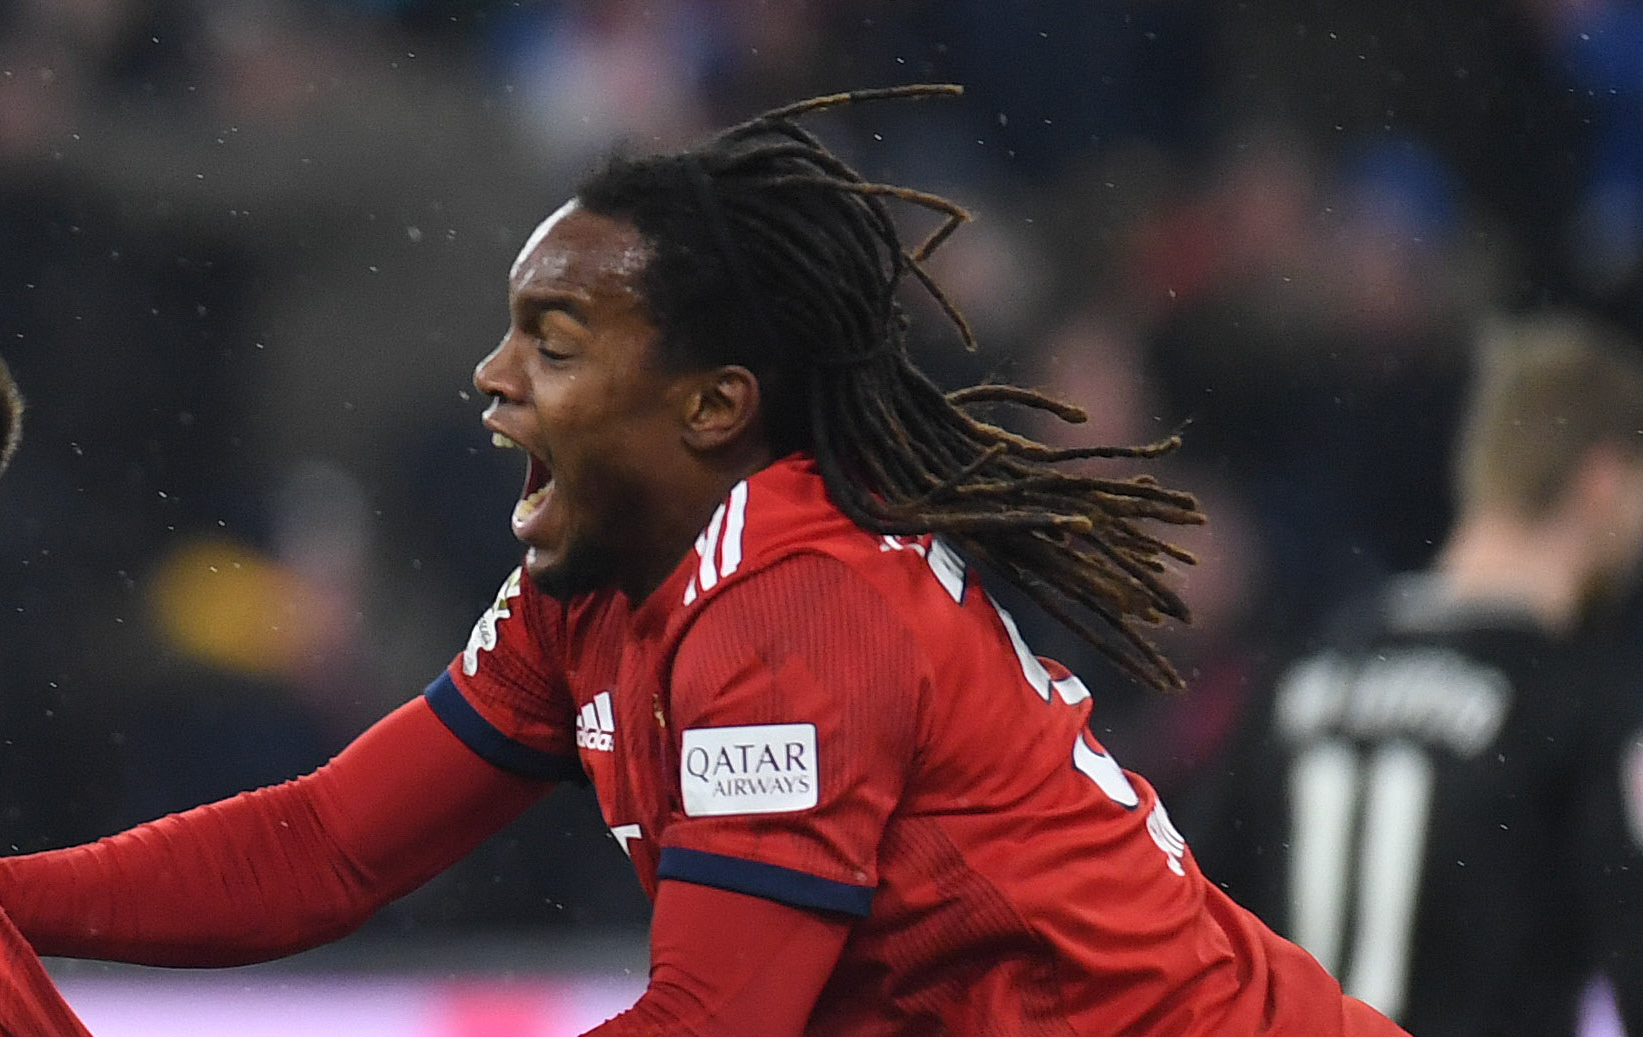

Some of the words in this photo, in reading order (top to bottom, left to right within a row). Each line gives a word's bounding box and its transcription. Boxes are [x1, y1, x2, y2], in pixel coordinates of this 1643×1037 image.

[686, 742, 807, 783] QATAR
[714, 775, 811, 797] AIRWAYS
[1289, 736, 1434, 1022] 11
